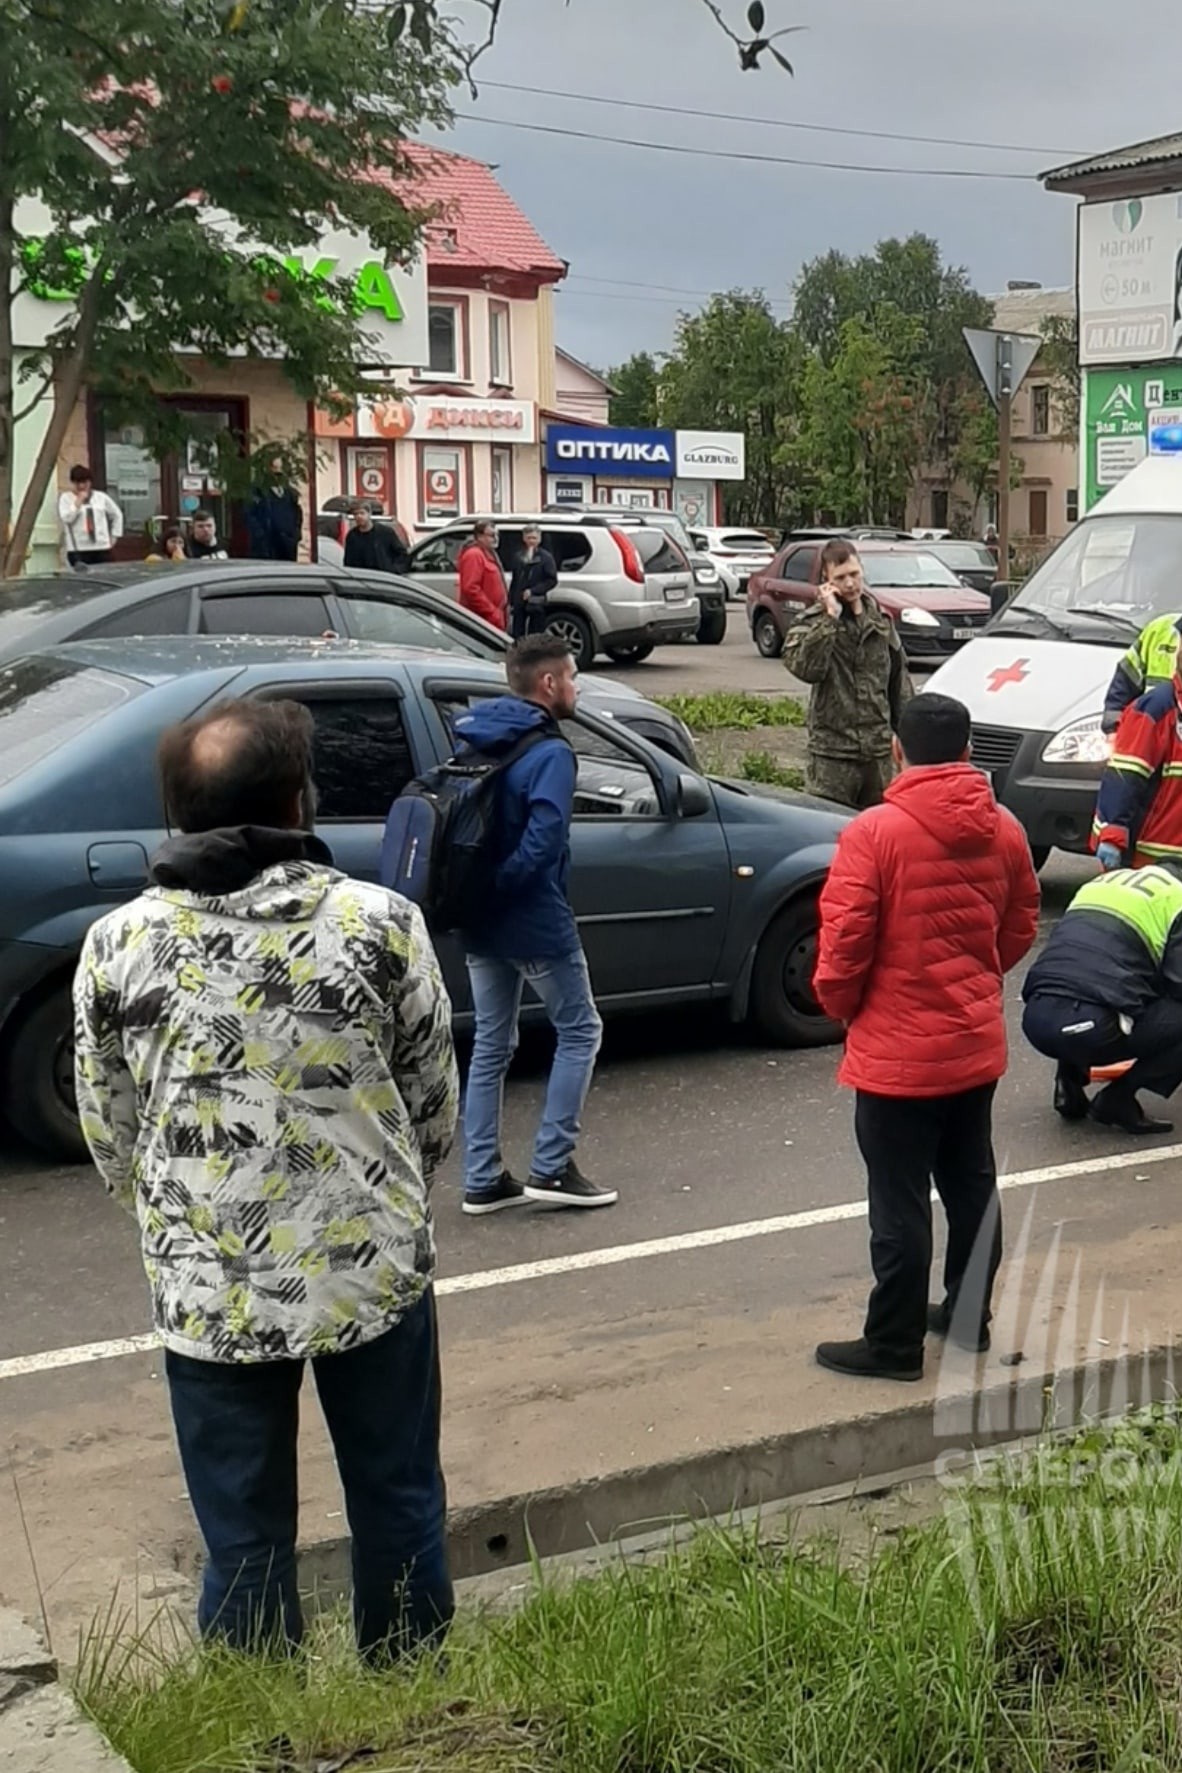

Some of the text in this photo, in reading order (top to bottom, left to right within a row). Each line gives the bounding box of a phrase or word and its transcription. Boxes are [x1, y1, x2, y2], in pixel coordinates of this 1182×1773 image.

[1088, 323, 1161, 349] МАГНИТ
[426, 407, 524, 430] ДИКСИ
[557, 440, 671, 463] ОПТИКА
[683, 452, 739, 465] GLAZBURG
[1096, 869, 1172, 898] ПС
